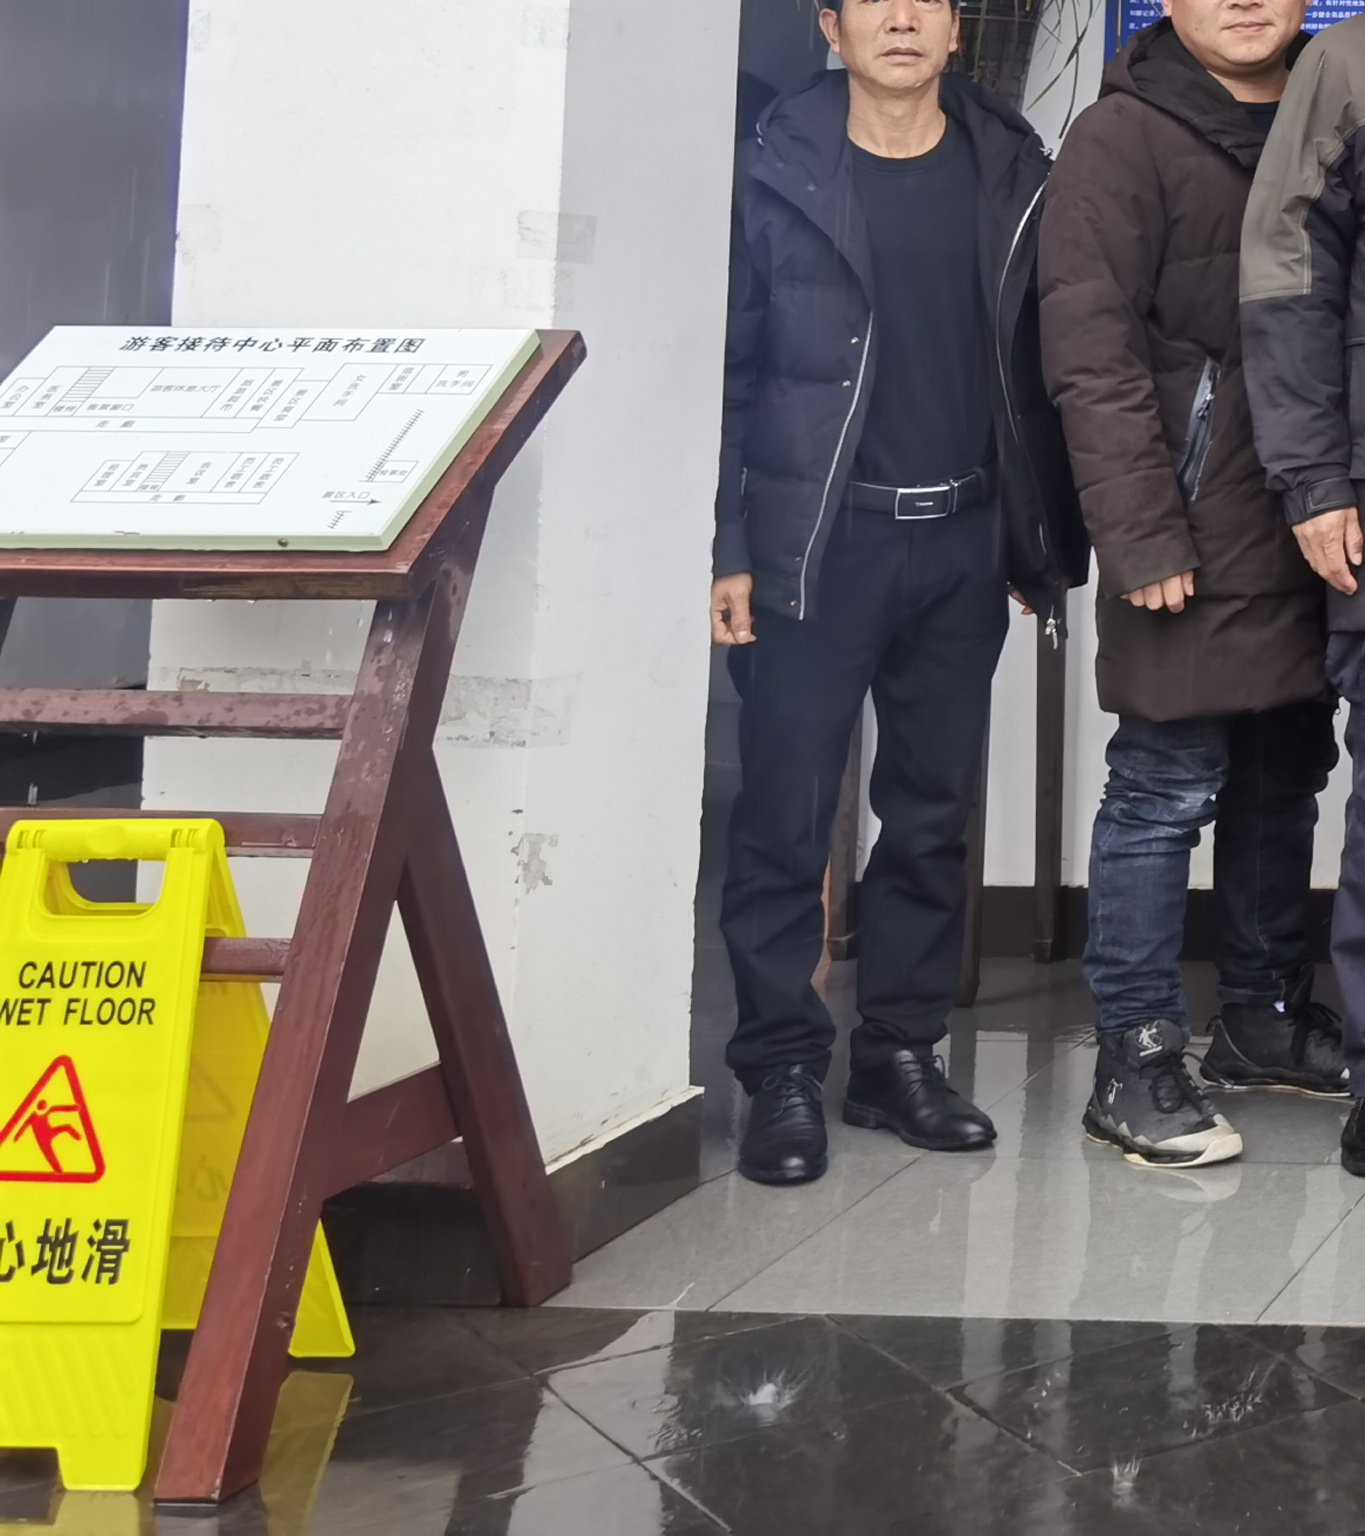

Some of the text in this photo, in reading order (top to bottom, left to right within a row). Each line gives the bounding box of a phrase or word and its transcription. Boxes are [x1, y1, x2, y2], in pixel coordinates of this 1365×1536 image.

[118, 336, 427, 354] 游客接待中心平面布置图
[19, 961, 147, 989] CAUTION
[63, 997, 156, 1026] FLOOR
